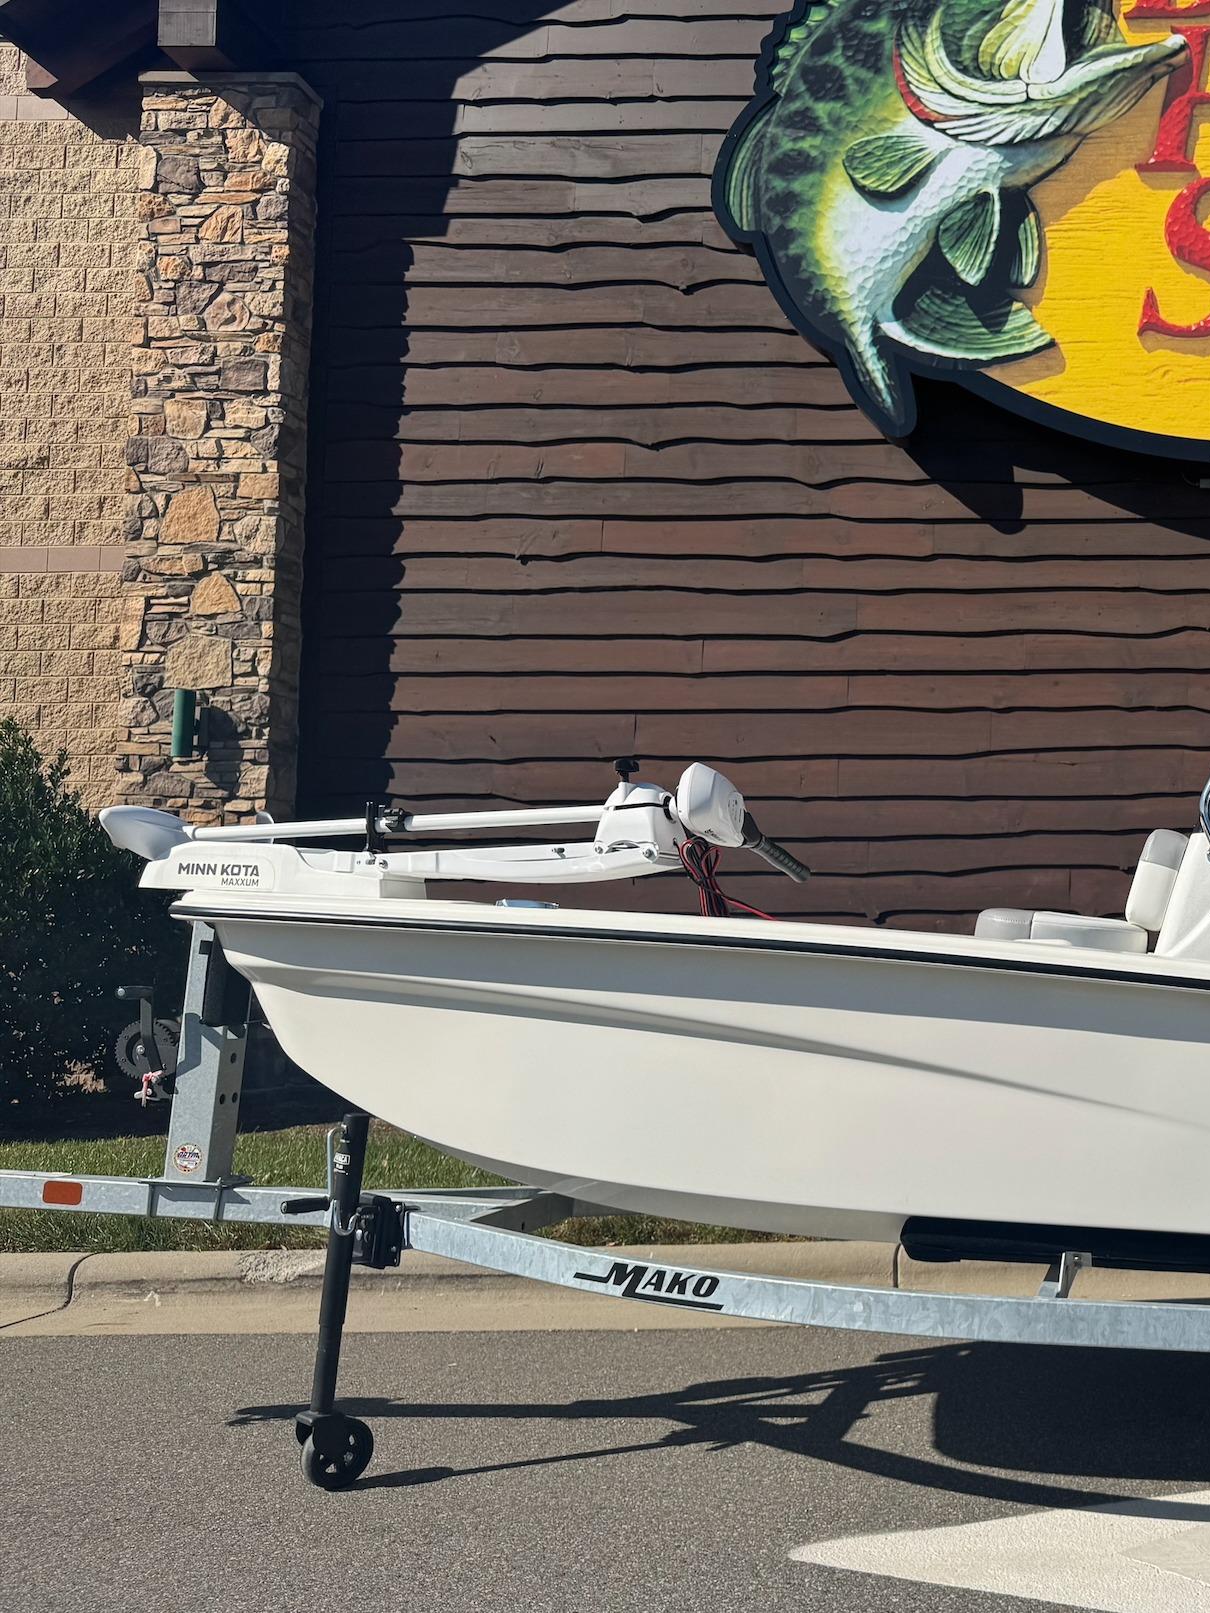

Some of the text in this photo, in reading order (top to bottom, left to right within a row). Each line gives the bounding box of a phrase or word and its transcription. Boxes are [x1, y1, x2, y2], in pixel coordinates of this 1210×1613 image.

[177, 862, 260, 877] MINN KOTA
[220, 877, 259, 887] MAXXUM
[573, 1262, 724, 1311] MAKO
